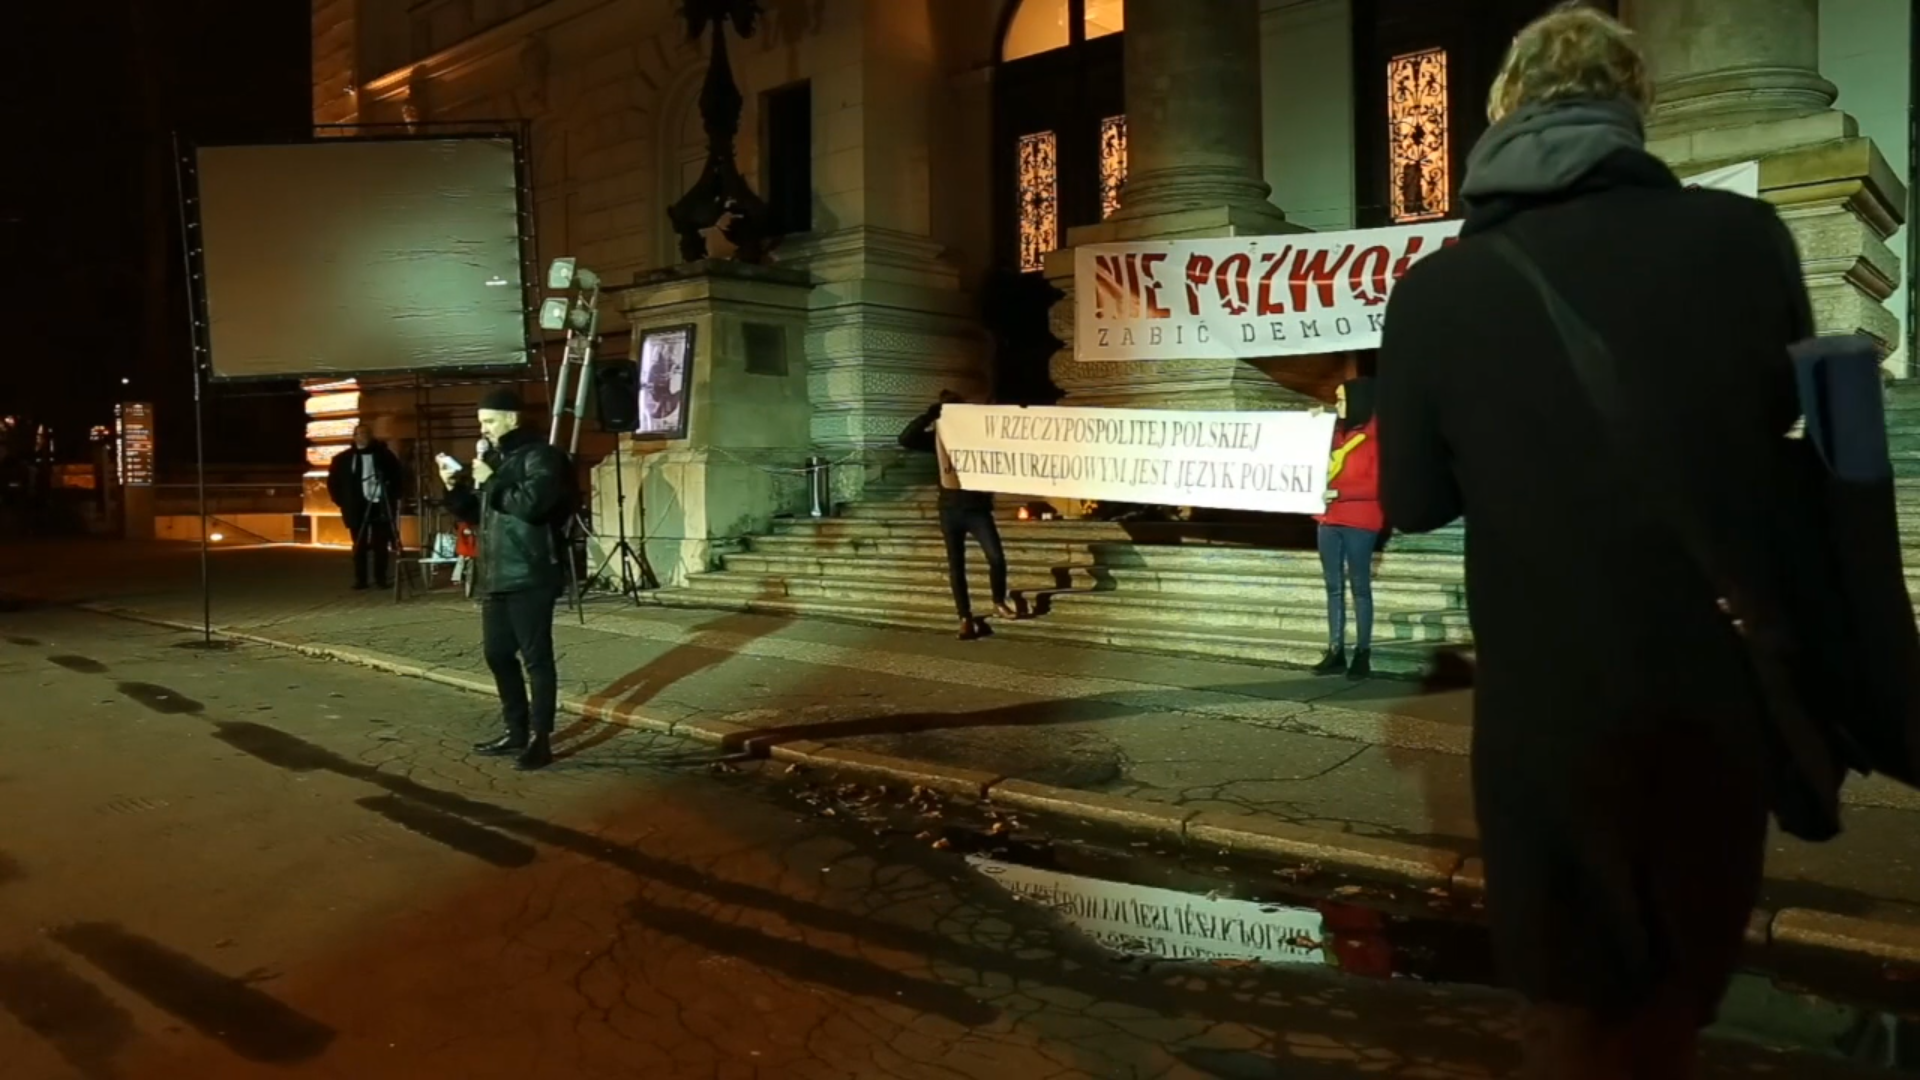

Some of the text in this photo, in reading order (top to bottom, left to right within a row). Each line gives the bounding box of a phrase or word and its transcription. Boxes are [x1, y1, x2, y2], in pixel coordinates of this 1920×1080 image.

[1095, 236, 1459, 320] NIE POZWO
[1097, 320, 1210, 347] ZABIĆ
[984, 414, 1263, 451] W RZECZYPOSPOLITEJ POLSKIEJ
[1019, 452, 1127, 486] URZĘDOWYM
[1129, 457, 1172, 486] JEST
[1174, 459, 1236, 493] JĘZYK
[1240, 462, 1314, 493] POLSKI
